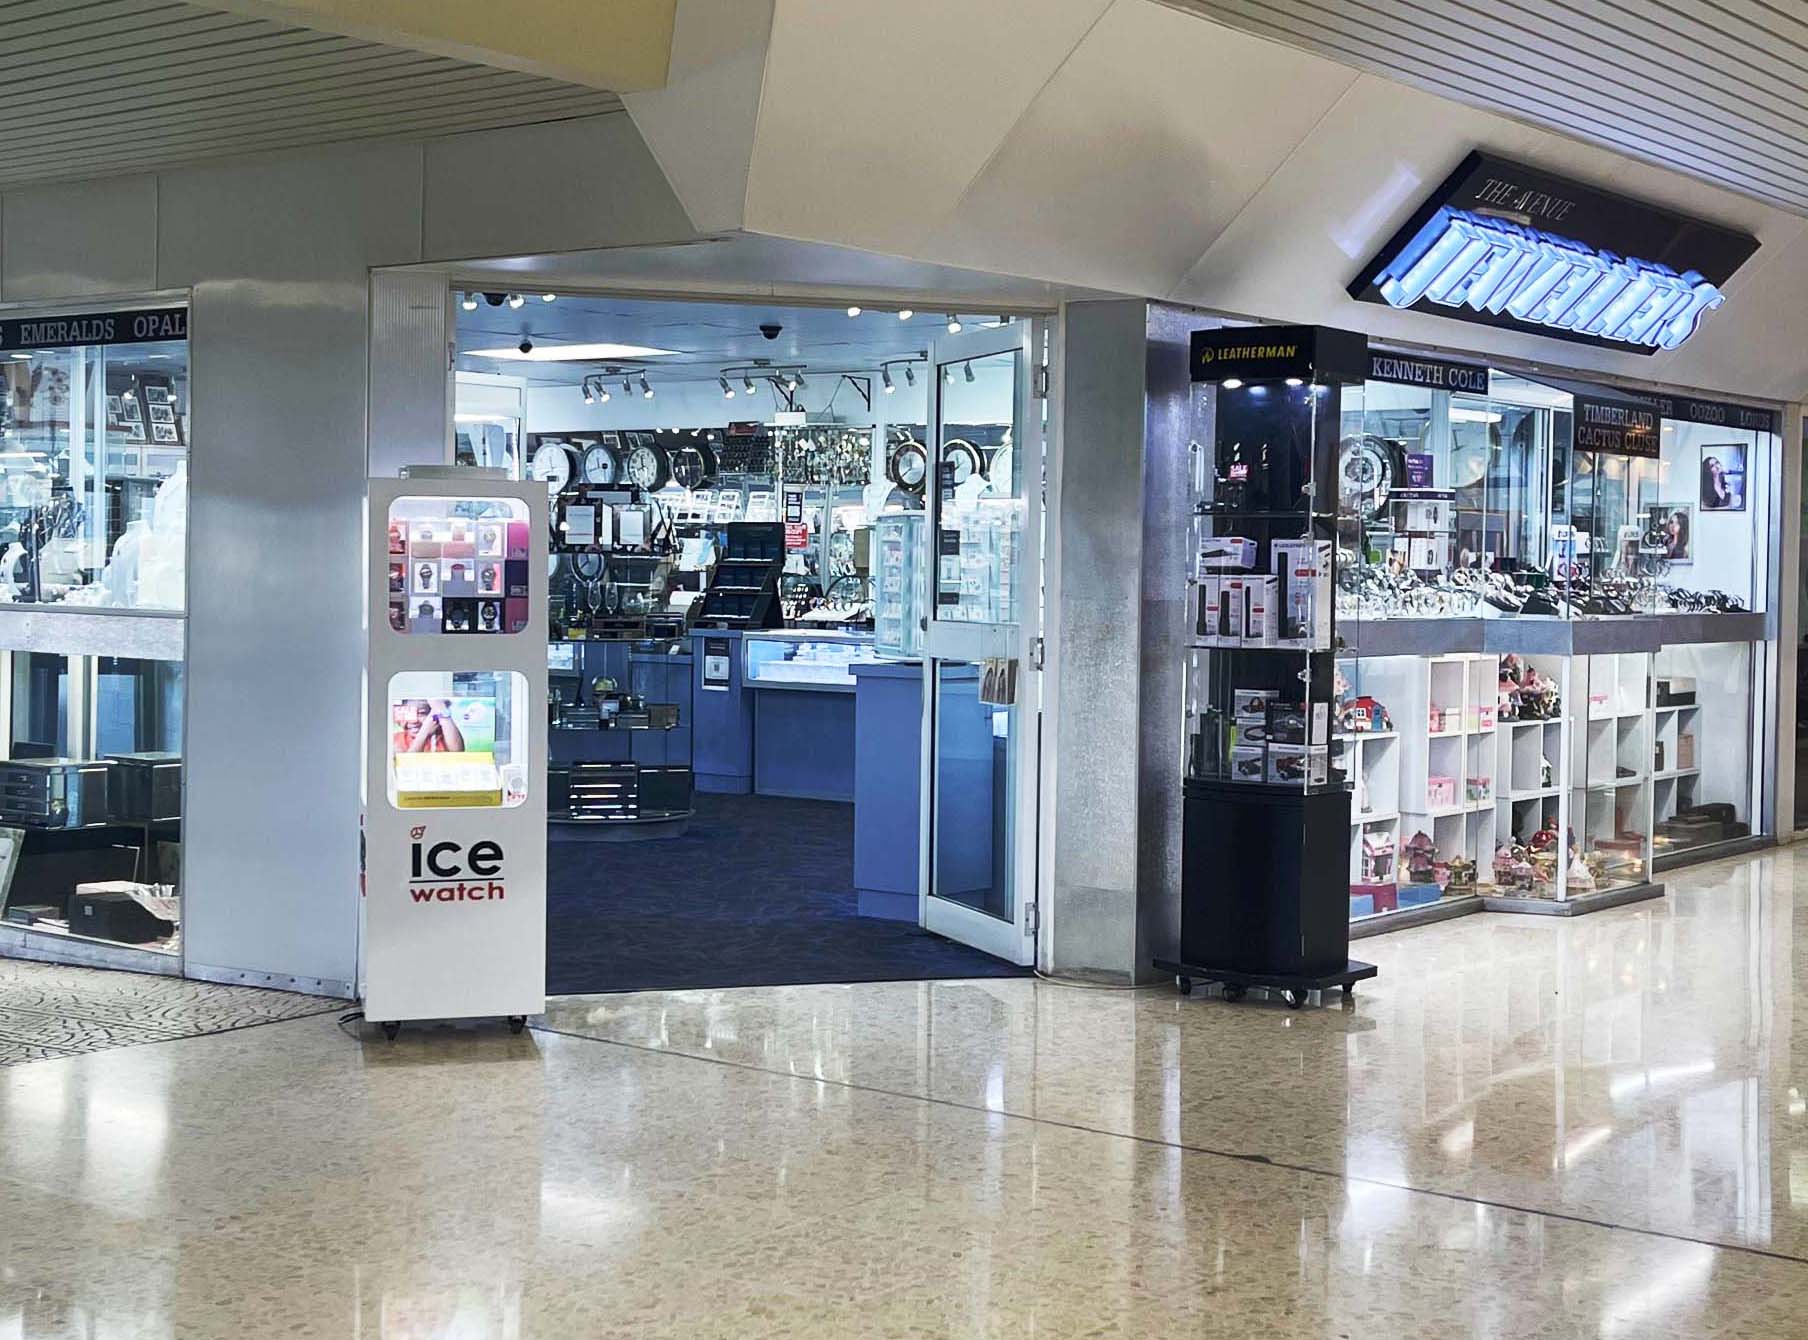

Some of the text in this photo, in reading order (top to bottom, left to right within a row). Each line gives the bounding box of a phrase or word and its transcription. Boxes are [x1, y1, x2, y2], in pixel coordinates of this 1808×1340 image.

[1474, 179, 1518, 205] THE
[1375, 206, 1726, 349] JEWELLERS
[20, 319, 115, 345] EMERALDS
[134, 314, 186, 338] OPAL
[1218, 345, 1296, 360] LEATHERMAN
[1372, 357, 1485, 390] KENNETH COLE
[1583, 404, 1653, 430] TIMBERLAND
[1578, 426, 1621, 447] CACTUS
[410, 826, 504, 877] ice
[410, 882, 504, 902] watch
